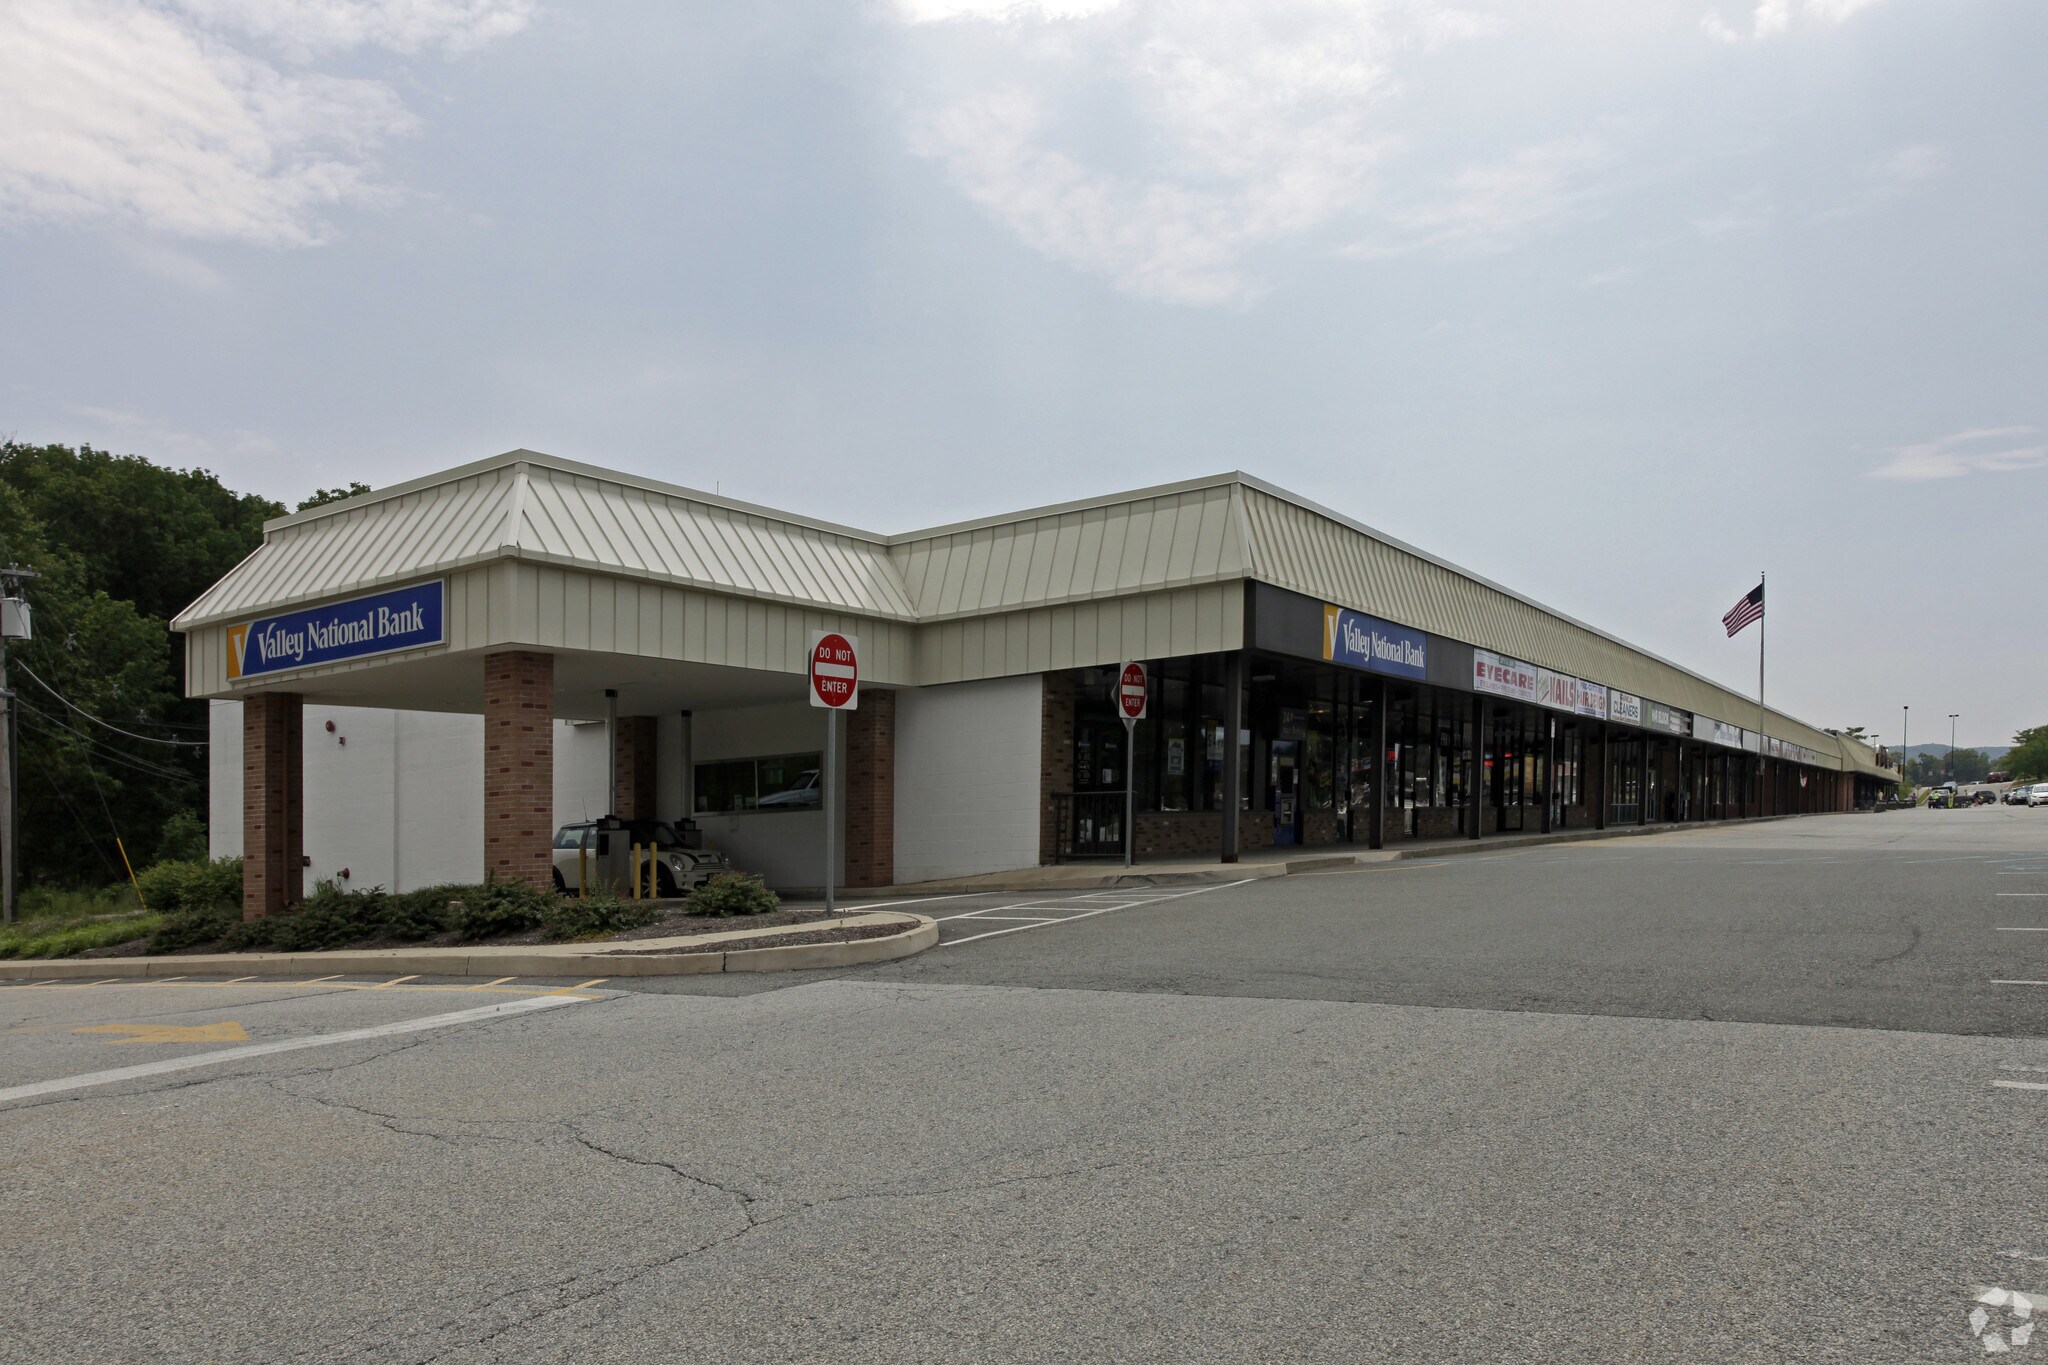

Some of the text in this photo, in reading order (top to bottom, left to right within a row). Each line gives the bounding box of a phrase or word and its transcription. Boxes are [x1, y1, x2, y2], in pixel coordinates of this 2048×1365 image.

[258, 622, 304, 665] Valley
[307, 610, 374, 651] National
[377, 601, 424, 638] Bank
[1343, 618, 1370, 662] Valley
[1371, 631, 1404, 664] National
[1404, 640, 1425, 668] Bank
[820, 647, 852, 662] DO NOT
[1124, 673, 1143, 683] DO NOT
[1476, 661, 1534, 690] EYECARE
[821, 680, 848, 693] ENTER
[1549, 675, 1574, 707] NAILS
[1125, 698, 1141, 707] ENTER
[1613, 700, 1639, 719] CLEANERS
